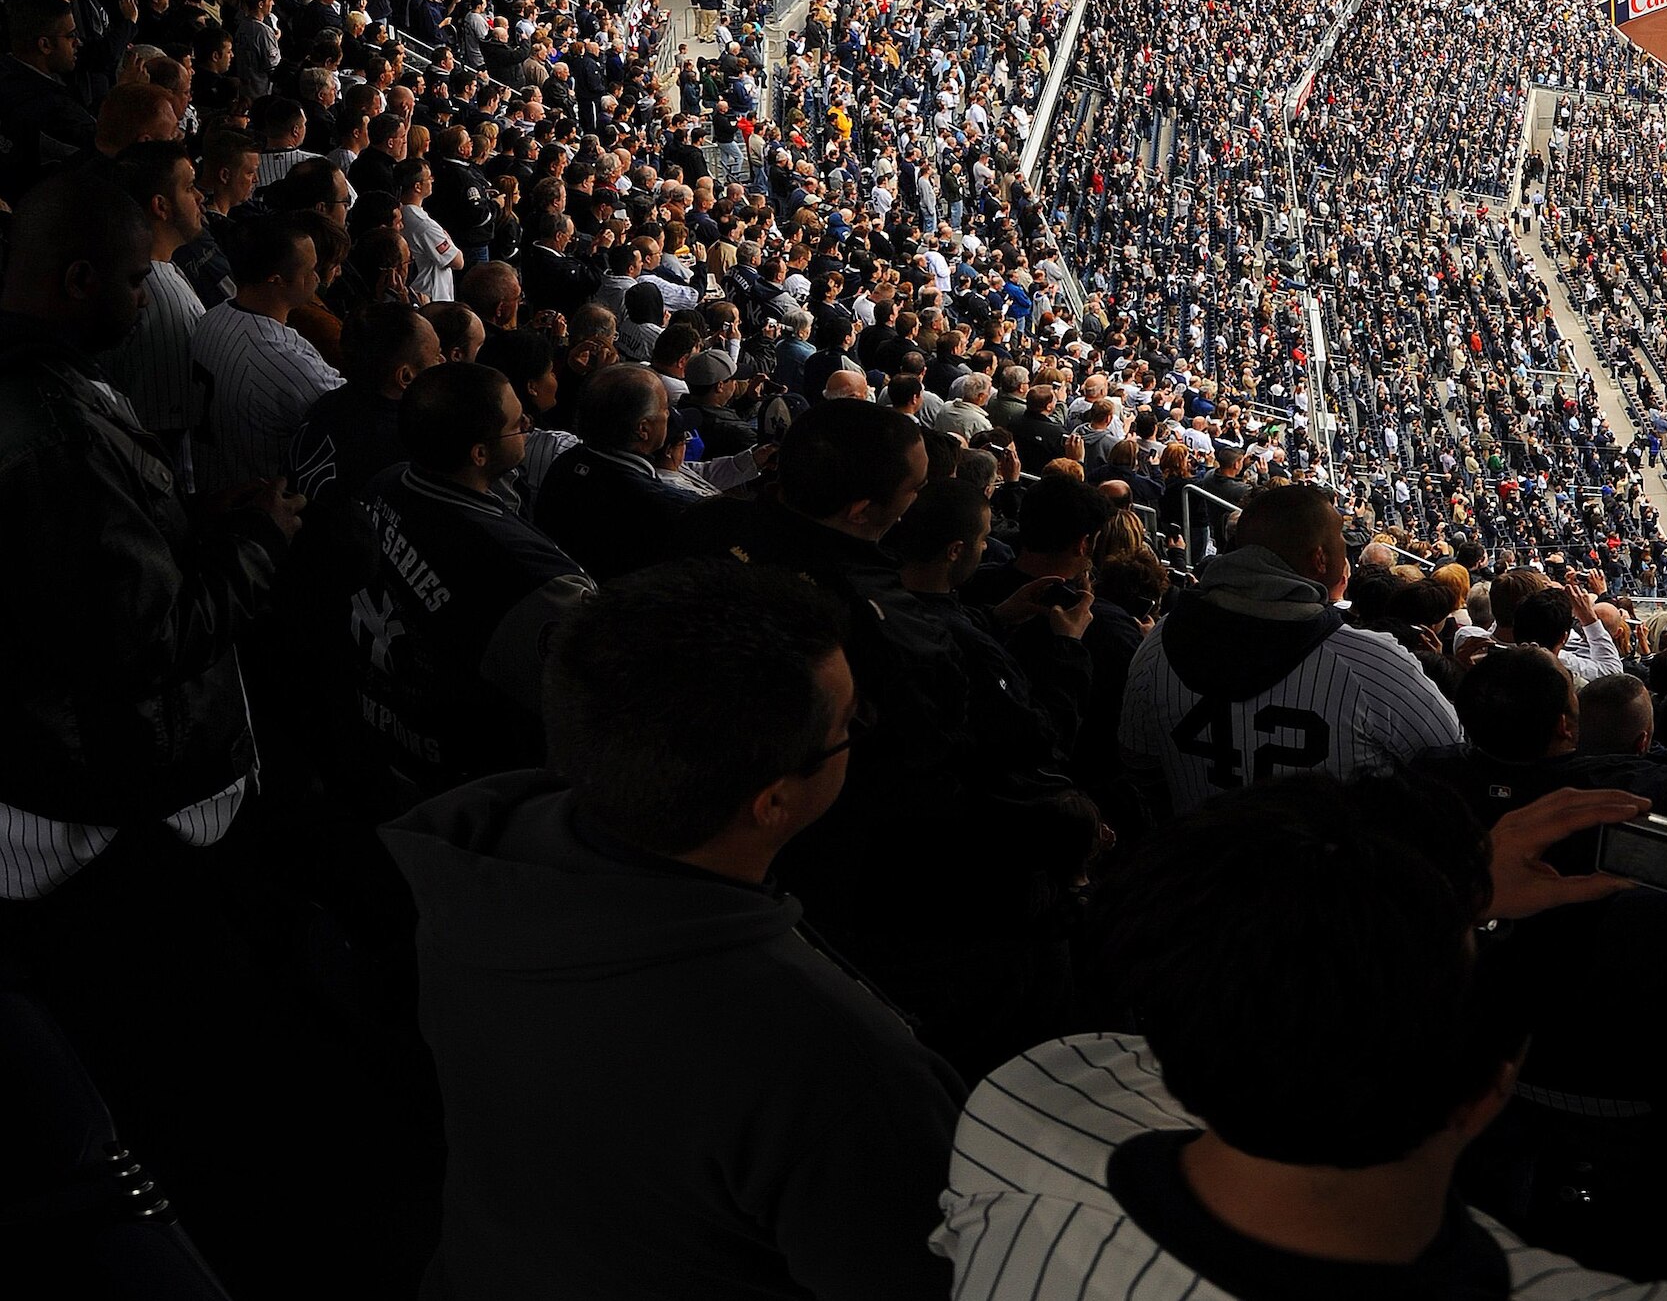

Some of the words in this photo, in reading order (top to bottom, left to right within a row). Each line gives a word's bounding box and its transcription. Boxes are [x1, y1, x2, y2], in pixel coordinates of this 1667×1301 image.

[380, 525, 452, 613] SERIES
[359, 690, 441, 764] MPIONS
[1170, 694, 1331, 789] 42
